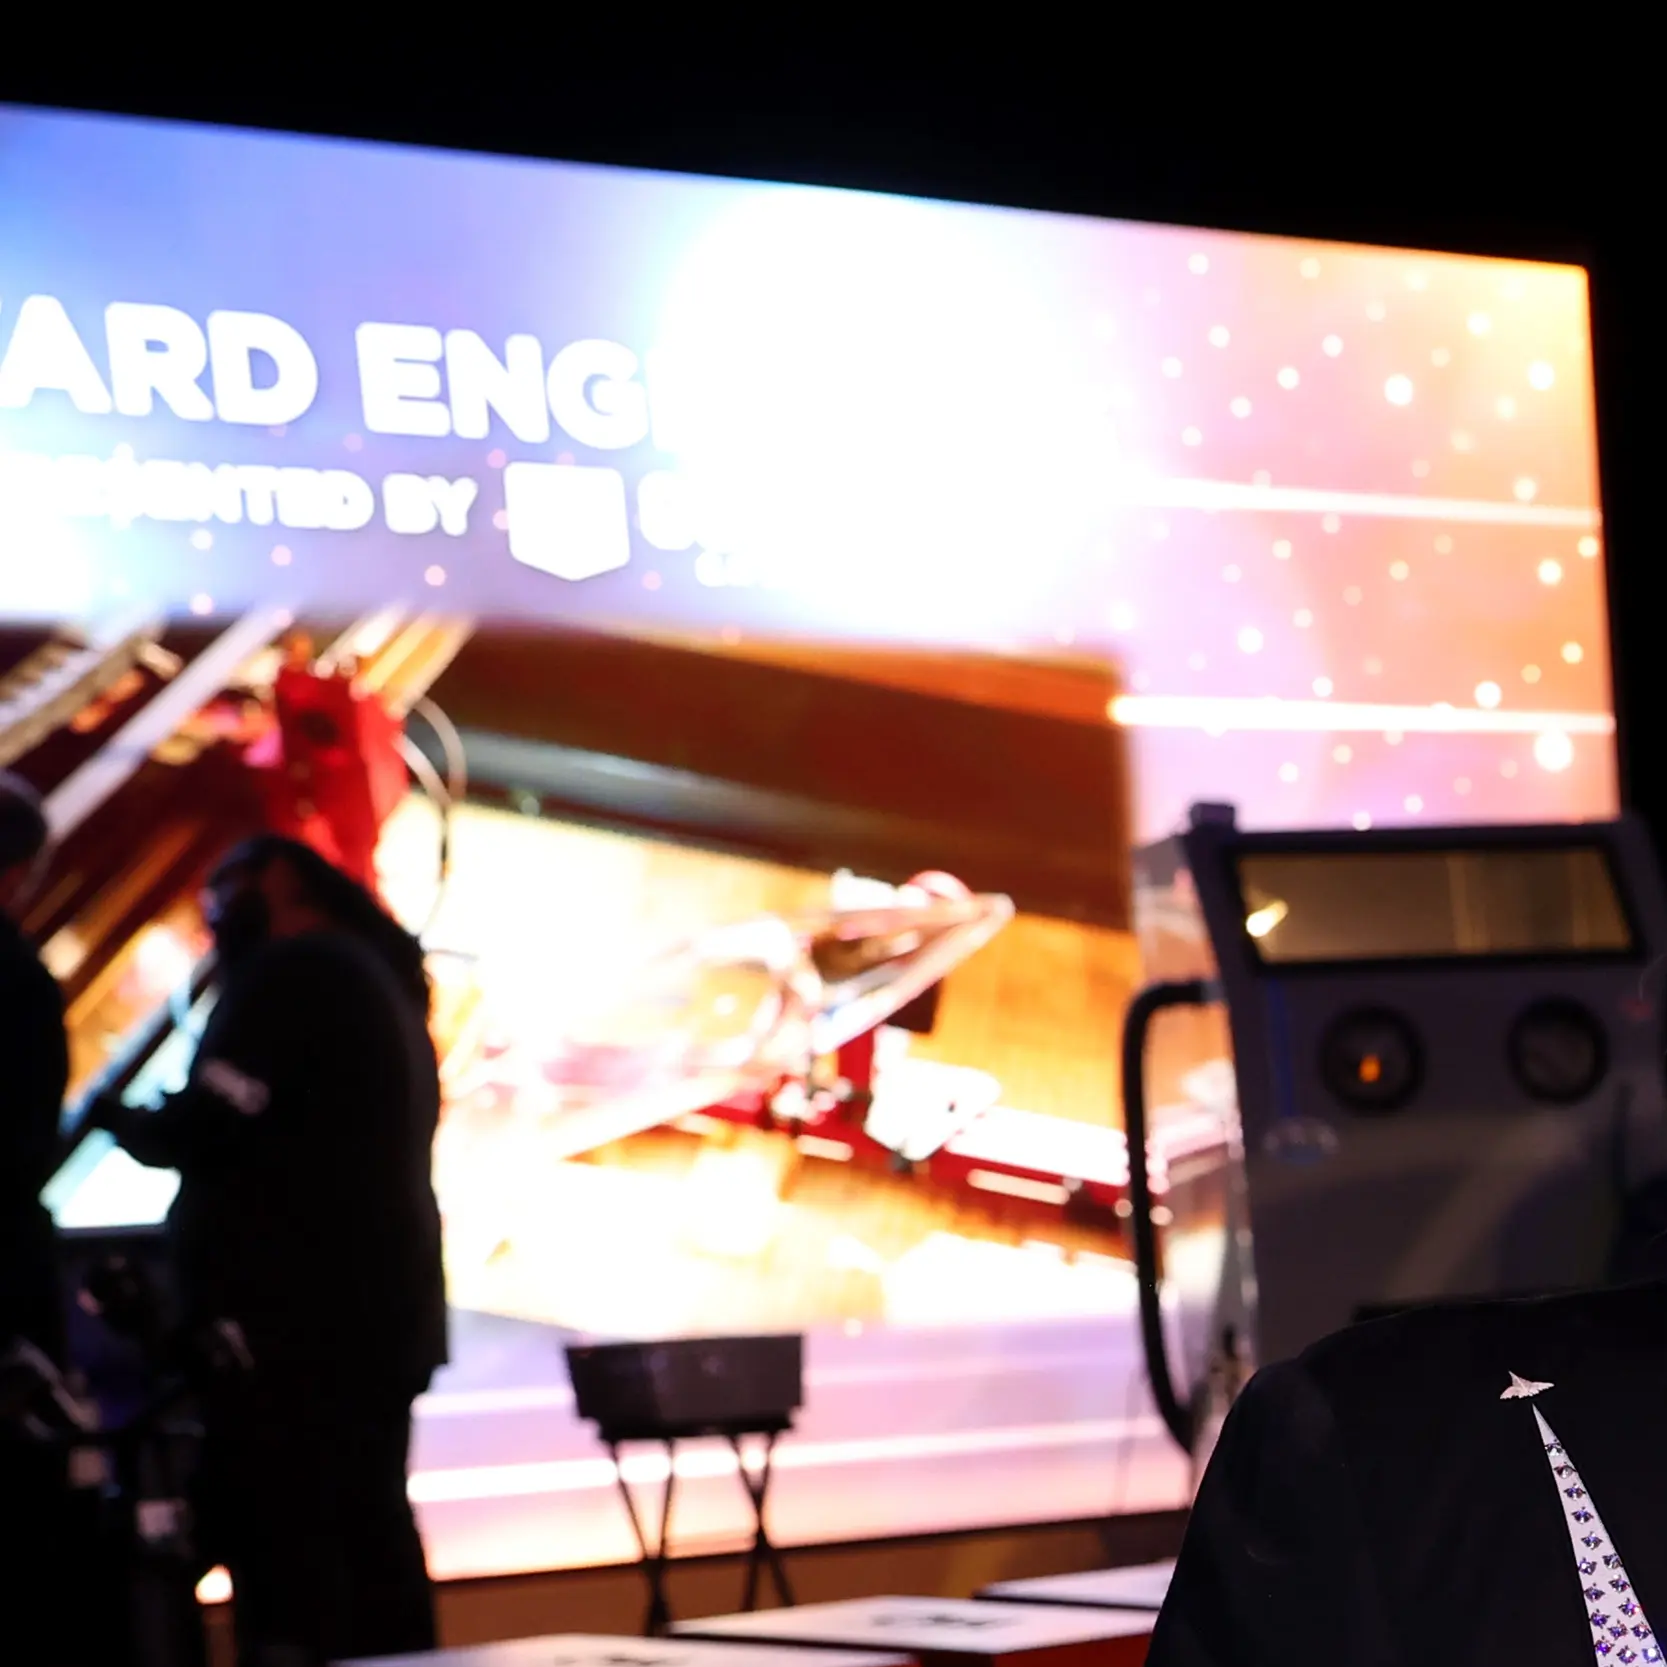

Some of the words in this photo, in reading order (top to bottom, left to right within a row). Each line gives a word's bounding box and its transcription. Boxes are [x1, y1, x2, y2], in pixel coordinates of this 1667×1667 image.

[0, 294, 318, 426] ARD
[355, 321, 658, 450] ENG
[382, 473, 478, 537] BY
